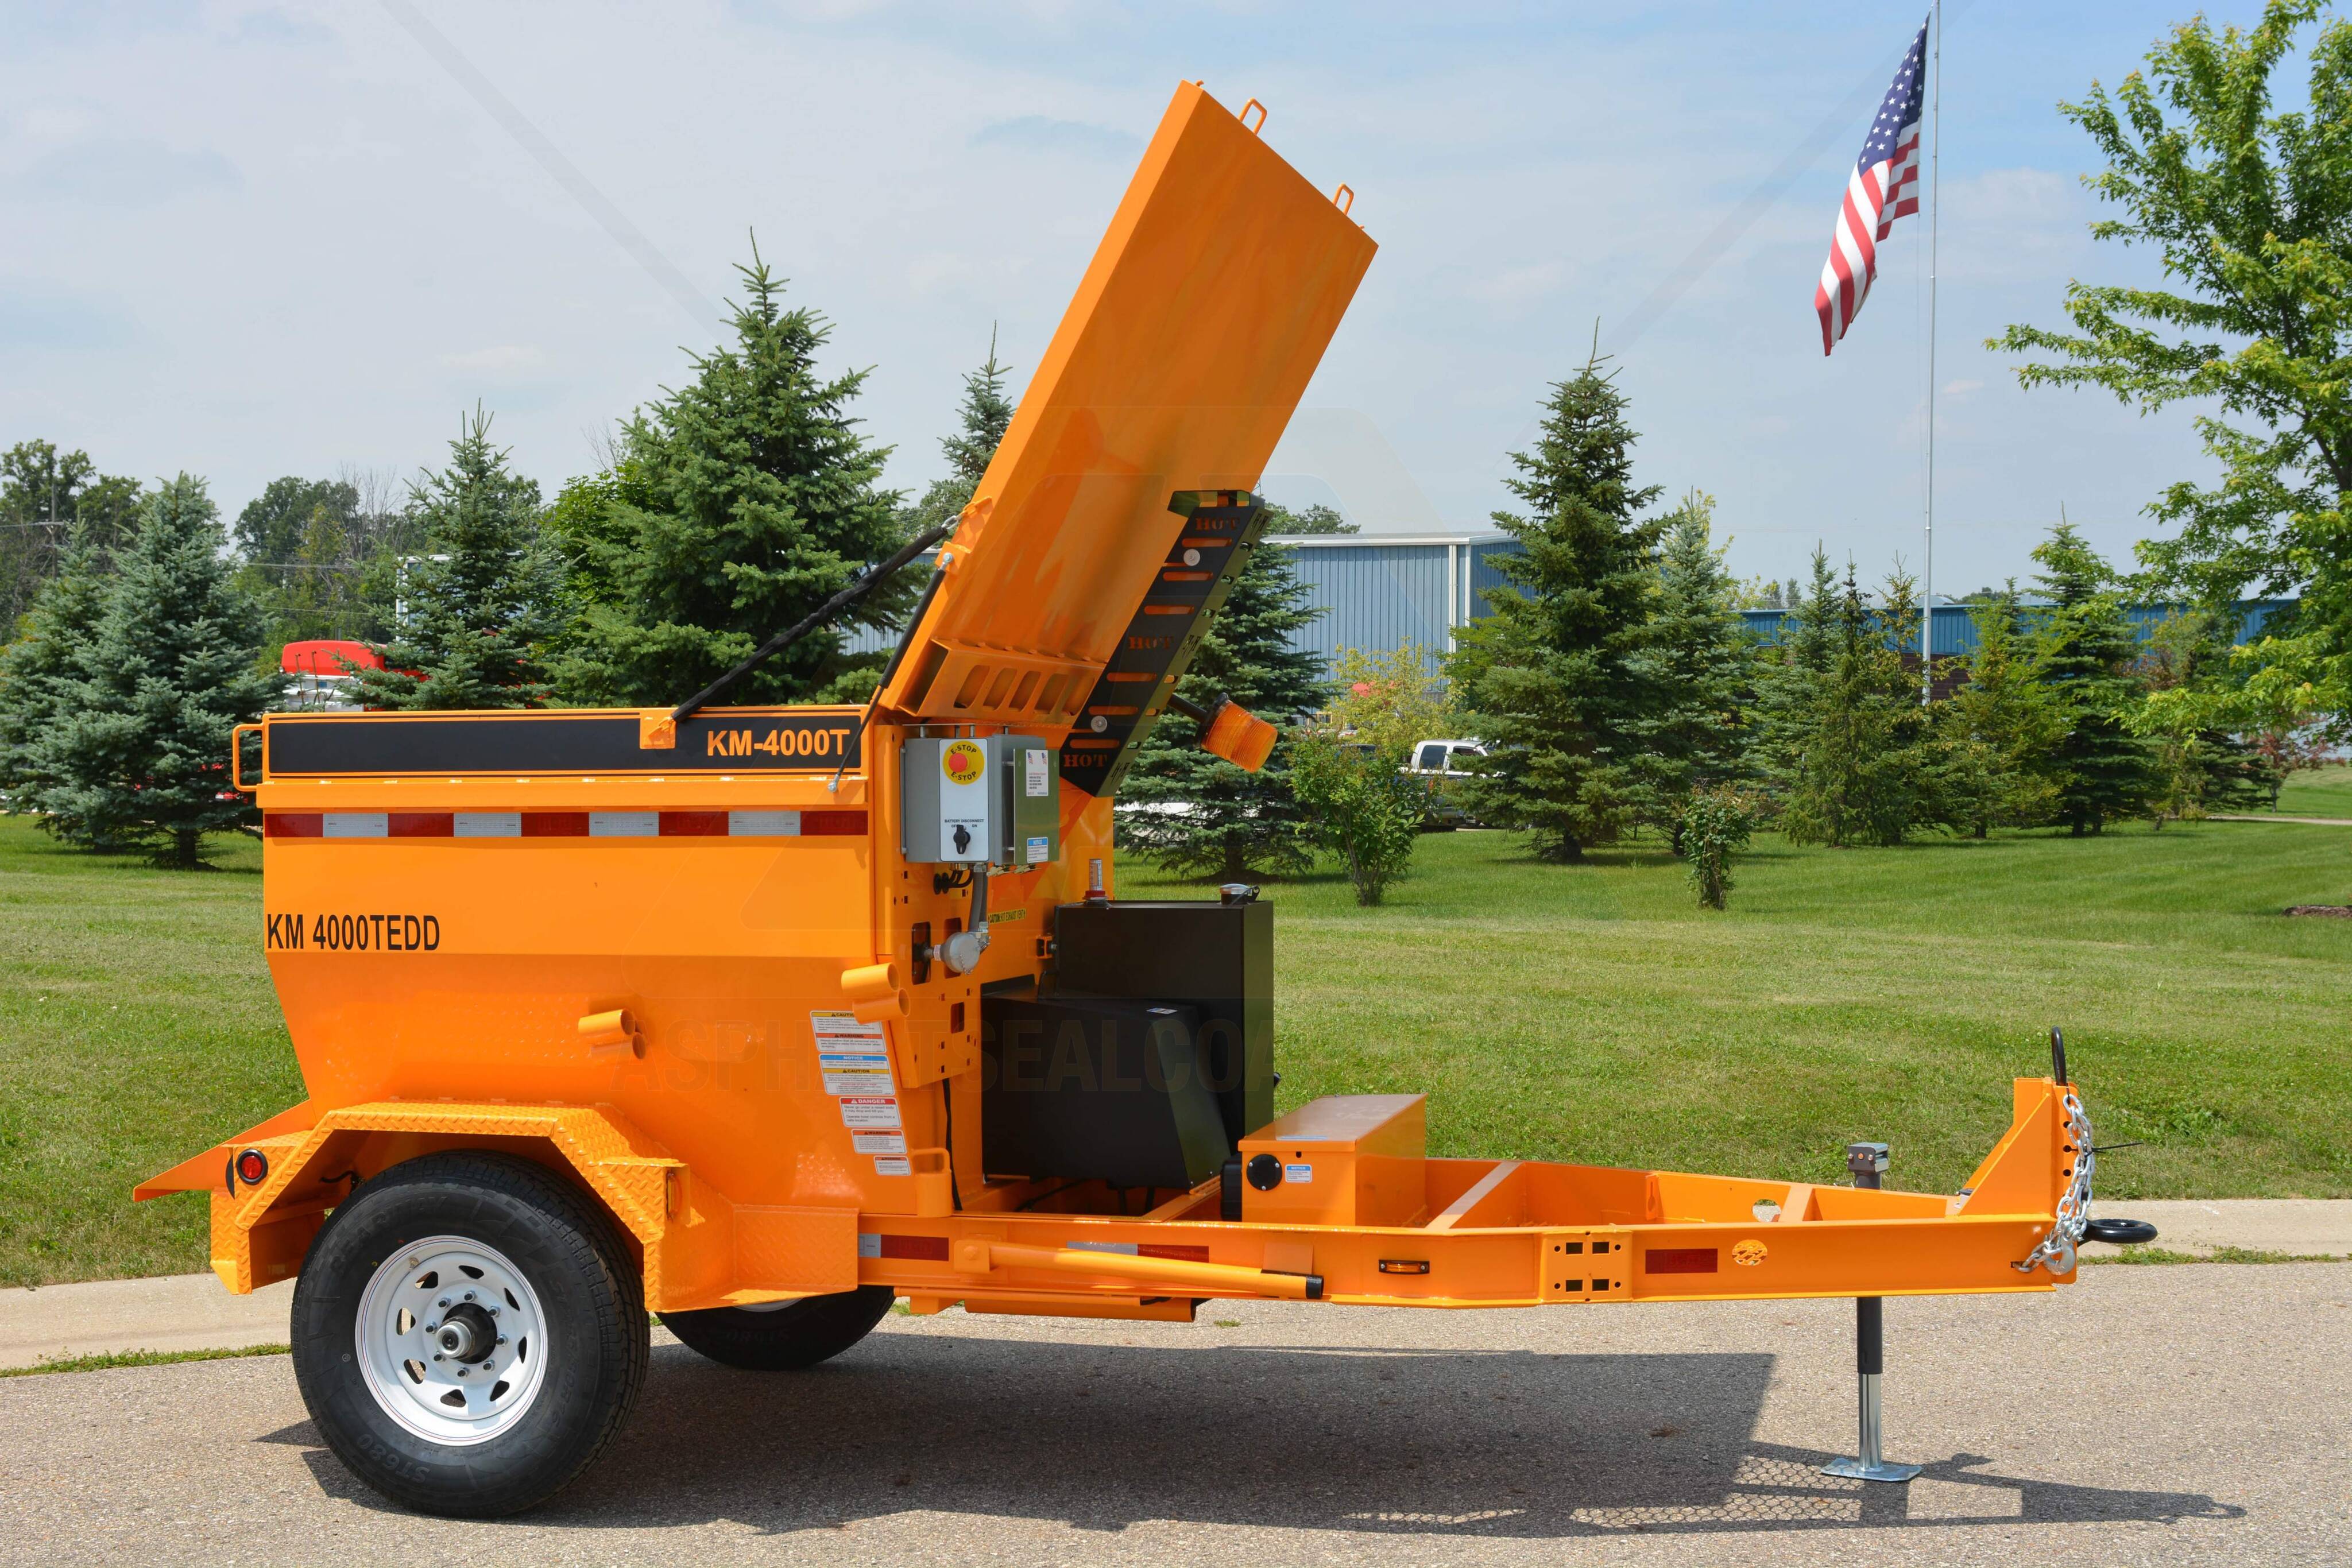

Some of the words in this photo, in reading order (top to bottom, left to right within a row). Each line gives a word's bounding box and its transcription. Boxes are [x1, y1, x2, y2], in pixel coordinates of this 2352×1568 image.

[1195, 517, 1240, 530] HOT
[1129, 636, 1174, 649] HOT
[707, 729, 850, 756] KM-4000T
[950, 744, 977, 754] E-STOP
[1063, 754, 1108, 767] HOT
[951, 771, 977, 781] E-STOP
[268, 914, 304, 949] KM
[312, 914, 440, 951] 4000TEDD
